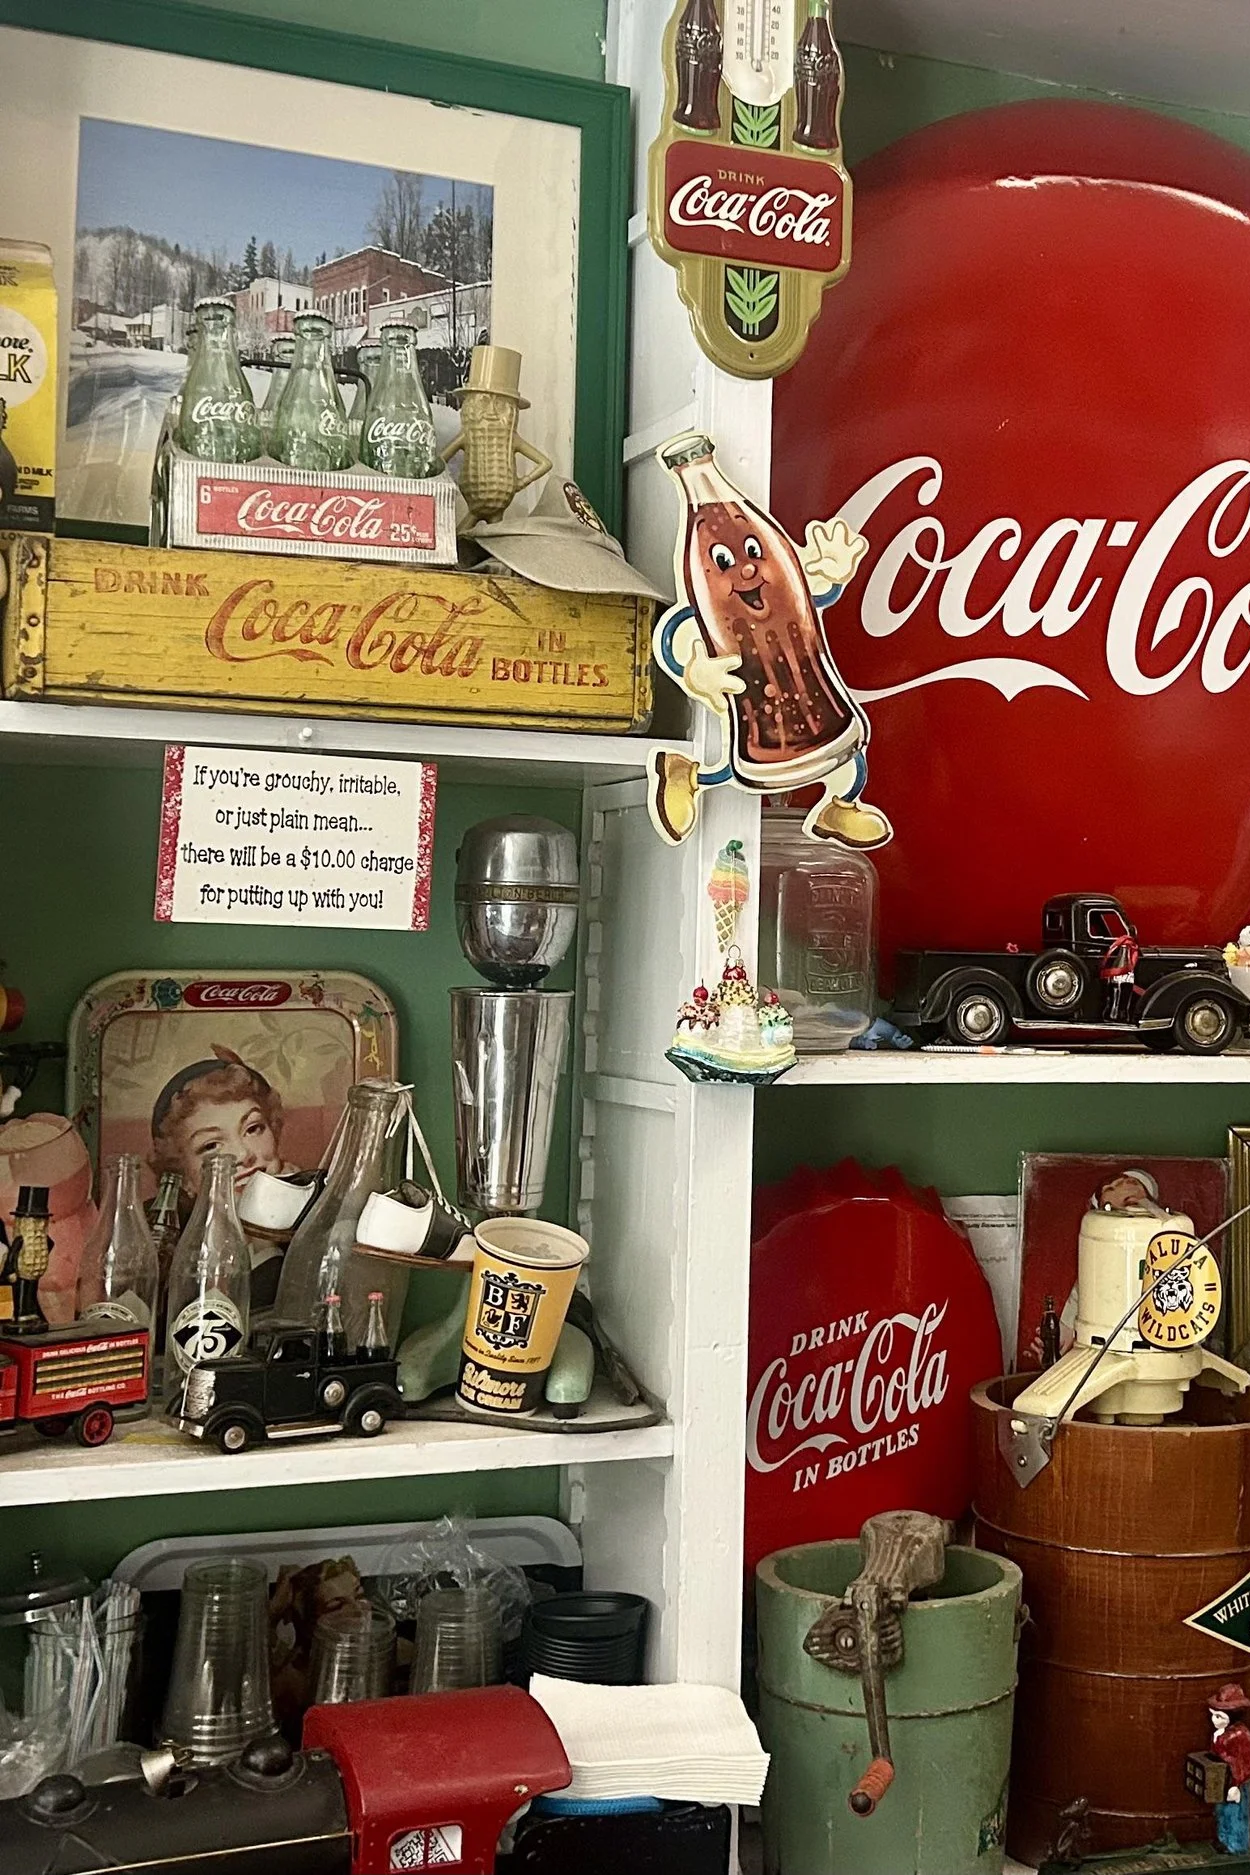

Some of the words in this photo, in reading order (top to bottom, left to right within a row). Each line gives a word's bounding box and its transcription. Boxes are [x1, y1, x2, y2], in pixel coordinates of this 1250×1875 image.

[716, 169, 766, 186] DRINK
[669, 175, 837, 246] Coca-Cola
[200, 485, 211, 504] 6
[237, 489, 386, 539] Coca-Cola
[94, 567, 210, 597] DRINK
[204, 579, 491, 678] Coca-Cola
[538, 631, 566, 653] IN
[492, 657, 609, 688] BOTTLES
[193, 765, 207, 786] If
[209, 767, 261, 789] you're
[265, 770, 334, 795] grouchy,
[339, 774, 401, 796] irritable,
[215, 808, 233, 826] or
[234, 807, 267, 830] just
[270, 808, 308, 833] plain
[313, 814, 373, 832] mean...
[181, 842, 225, 864] there
[230, 846, 256, 867] will
[260, 846, 281, 866] be
[286, 852, 296, 867] a
[300, 846, 355, 870] $10.00
[360, 850, 414, 874] charge
[200, 884, 225, 905] for
[228, 885, 283, 909] putting
[288, 889, 308, 911] up
[312, 888, 345, 909] with
[349, 890, 384, 912] you!
[200, 984, 283, 1002] Coca-Cola
[485, 1284, 503, 1306] B
[505, 1313, 527, 1335] F
[789, 1310, 869, 1356] DRINK
[1141, 1301, 1215, 1342] WILDCATS
[463, 1362, 527, 1396] Biltmore
[746, 1297, 949, 1473] Coca-Cola
[793, 1463, 820, 1492] IN
[825, 1423, 920, 1479] BOTTLES
